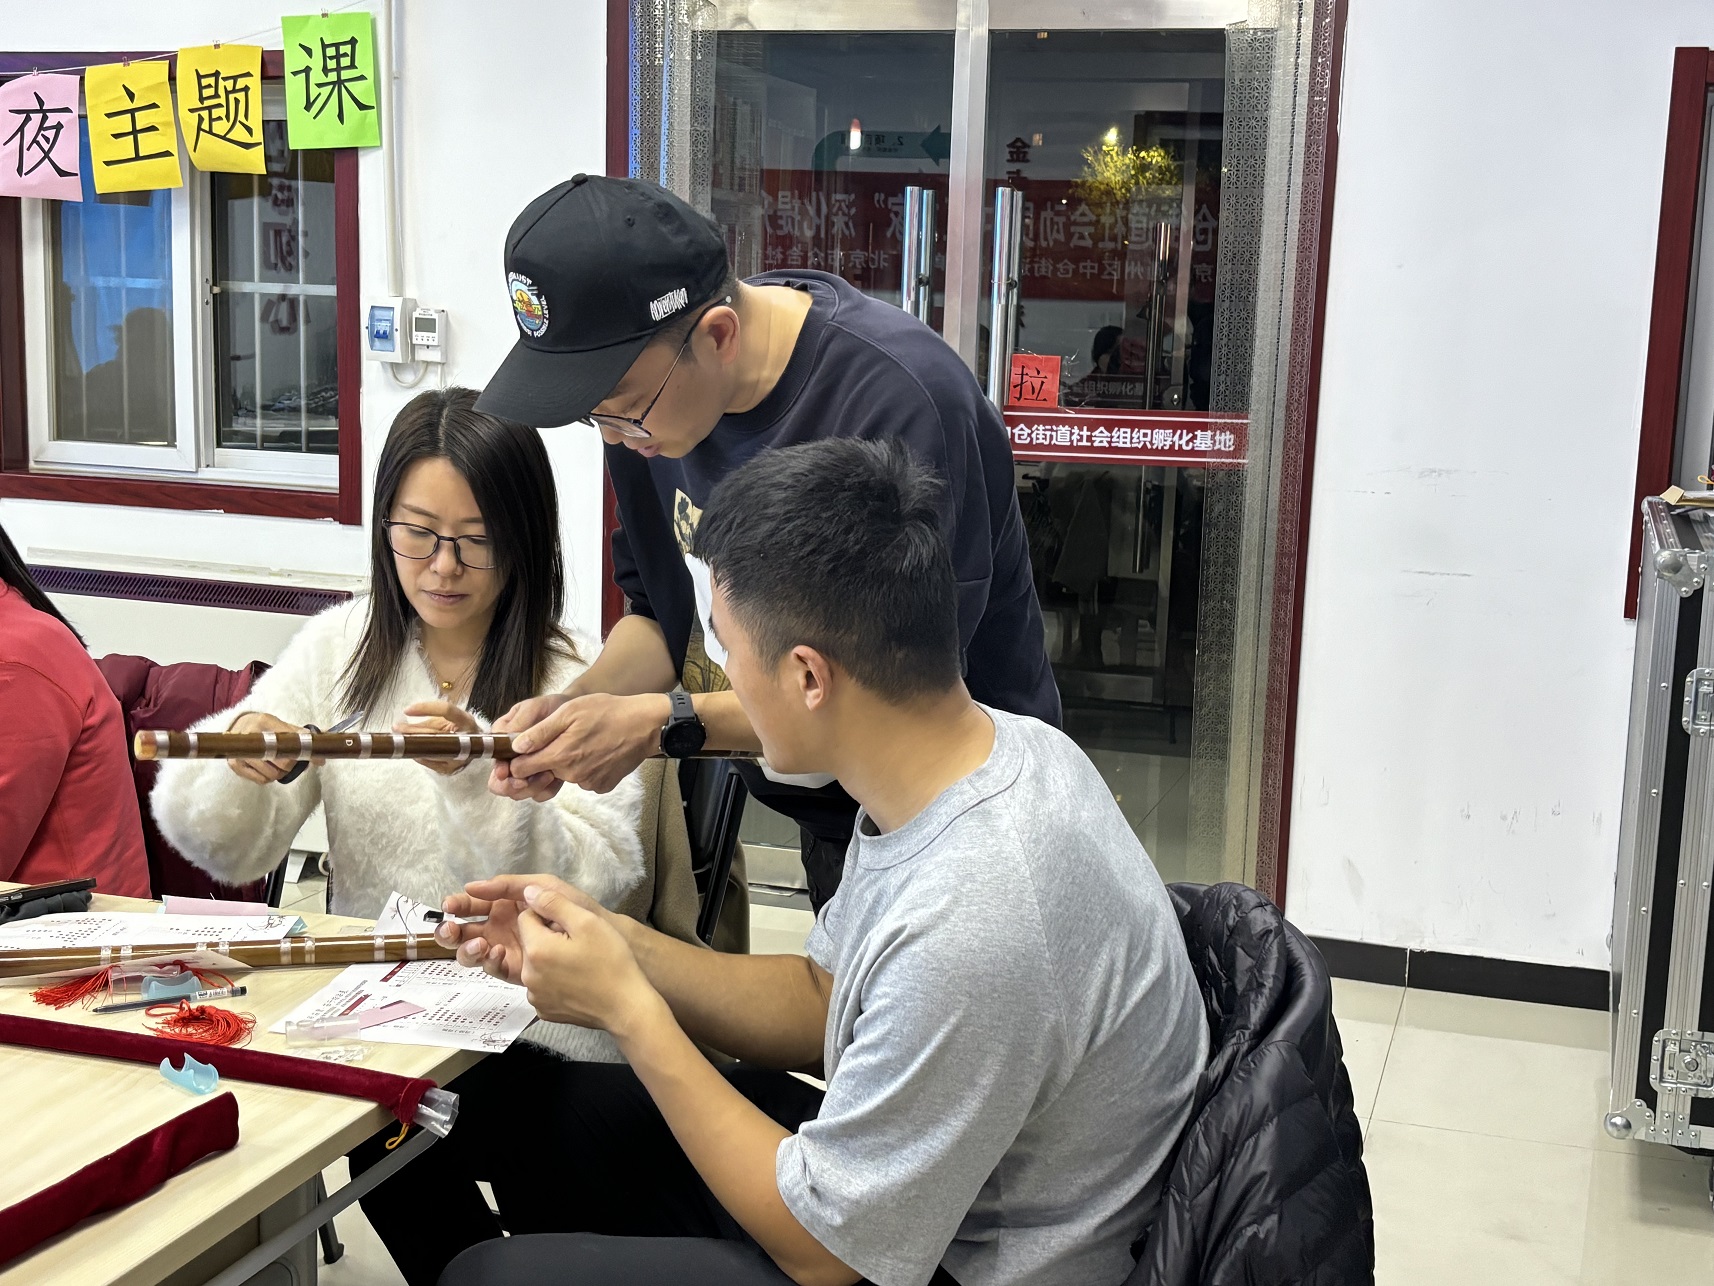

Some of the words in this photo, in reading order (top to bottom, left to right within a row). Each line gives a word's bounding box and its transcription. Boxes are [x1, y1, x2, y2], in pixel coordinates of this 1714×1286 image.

[3, 36, 375, 178] 夜主题课
[1013, 365, 1048, 402] 拉
